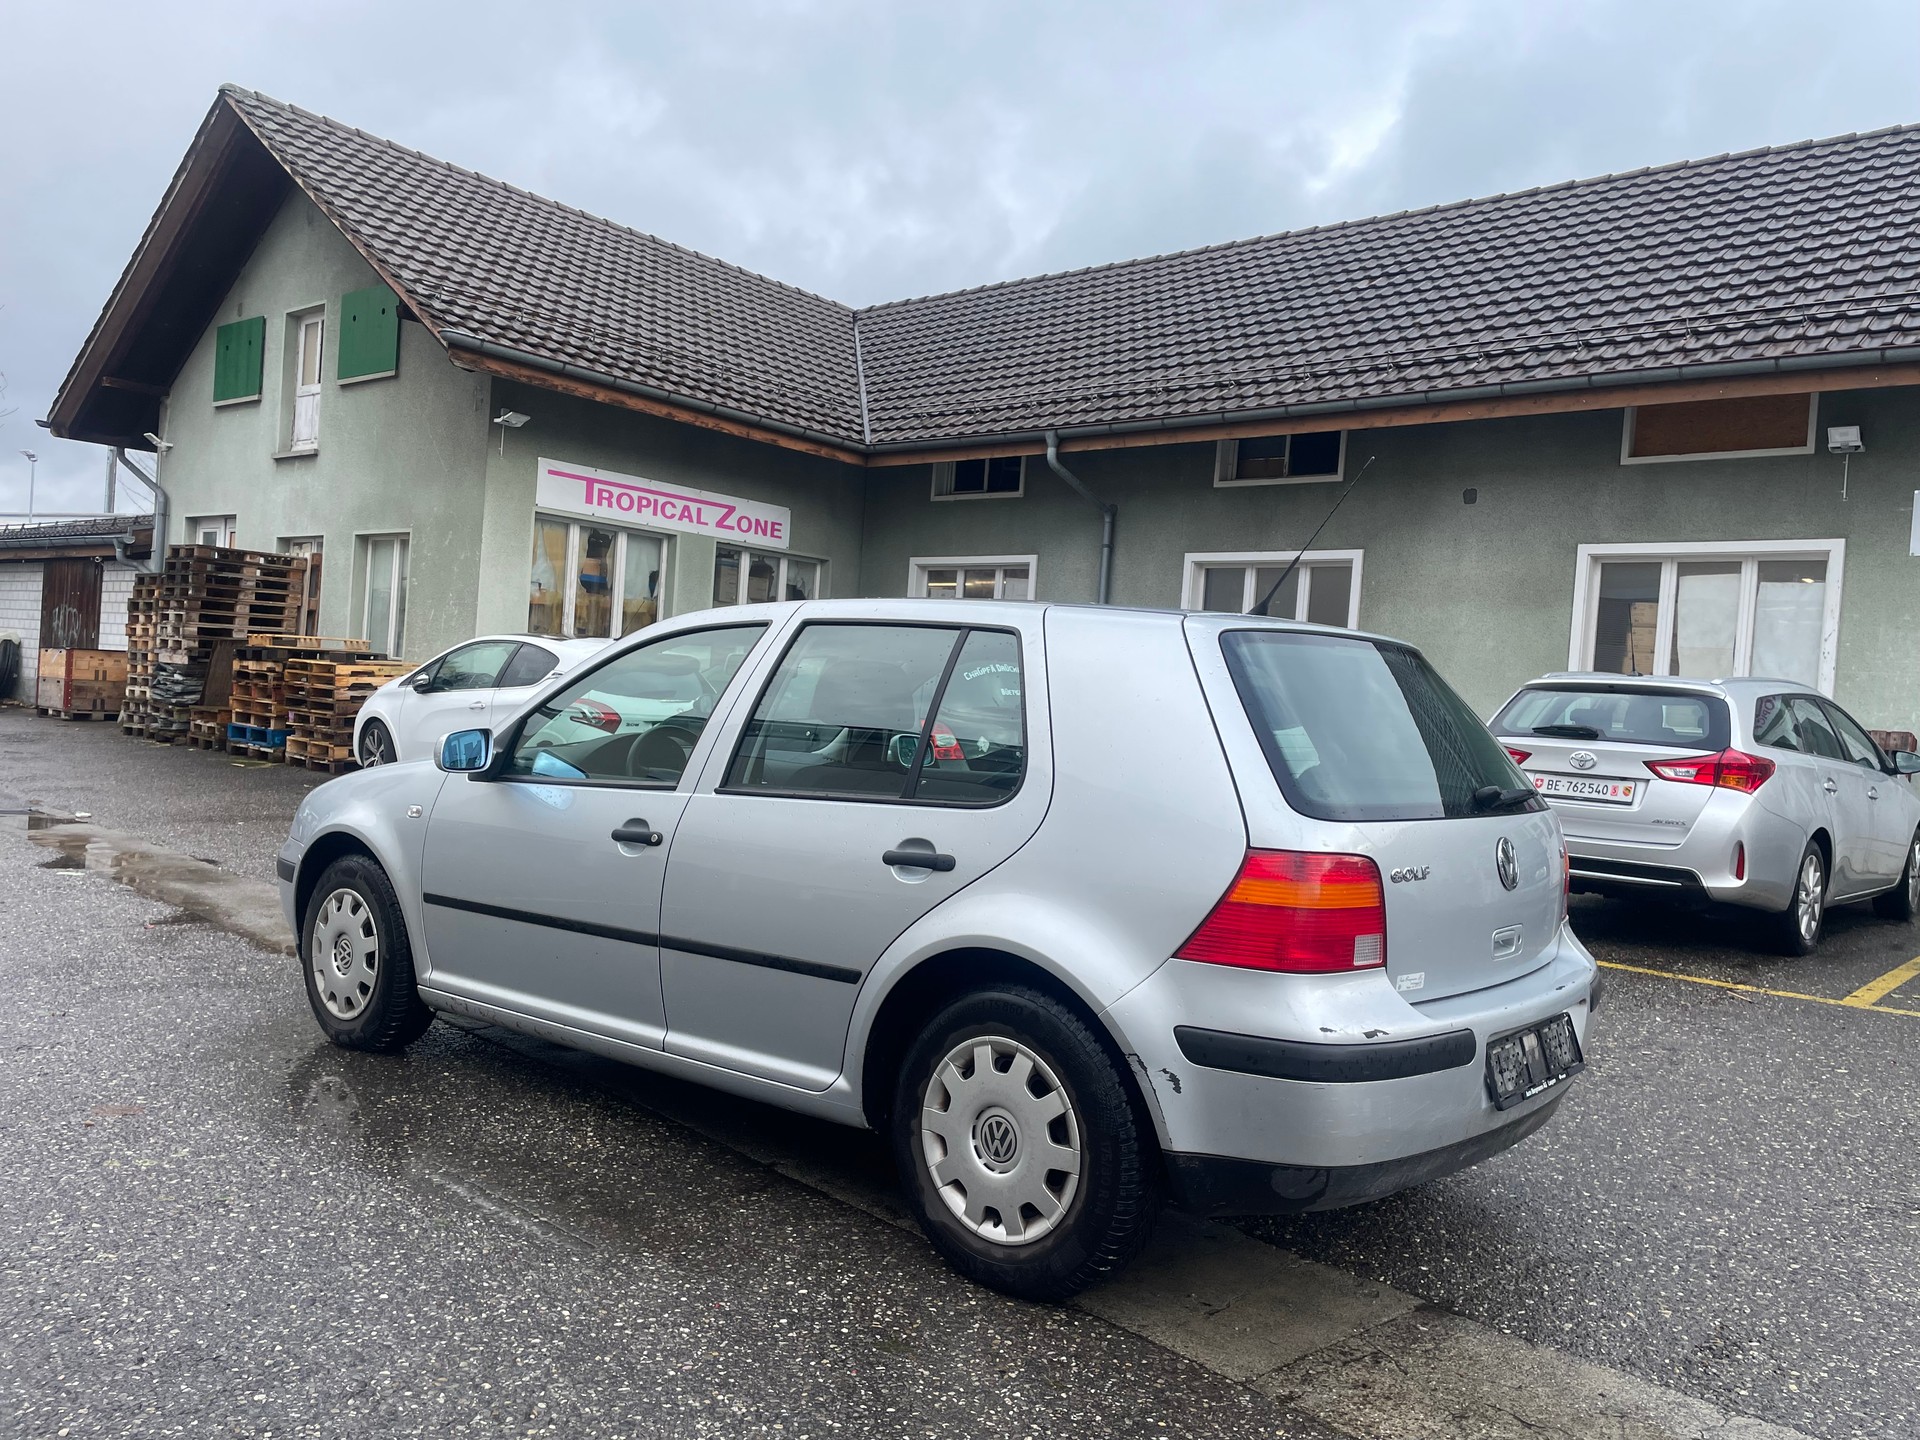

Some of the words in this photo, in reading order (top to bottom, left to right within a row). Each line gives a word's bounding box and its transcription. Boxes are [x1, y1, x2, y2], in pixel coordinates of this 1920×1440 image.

[547, 469, 709, 526] TROPICAL
[715, 504, 783, 540] ZONE
[1390, 865, 1431, 884] GOLF
